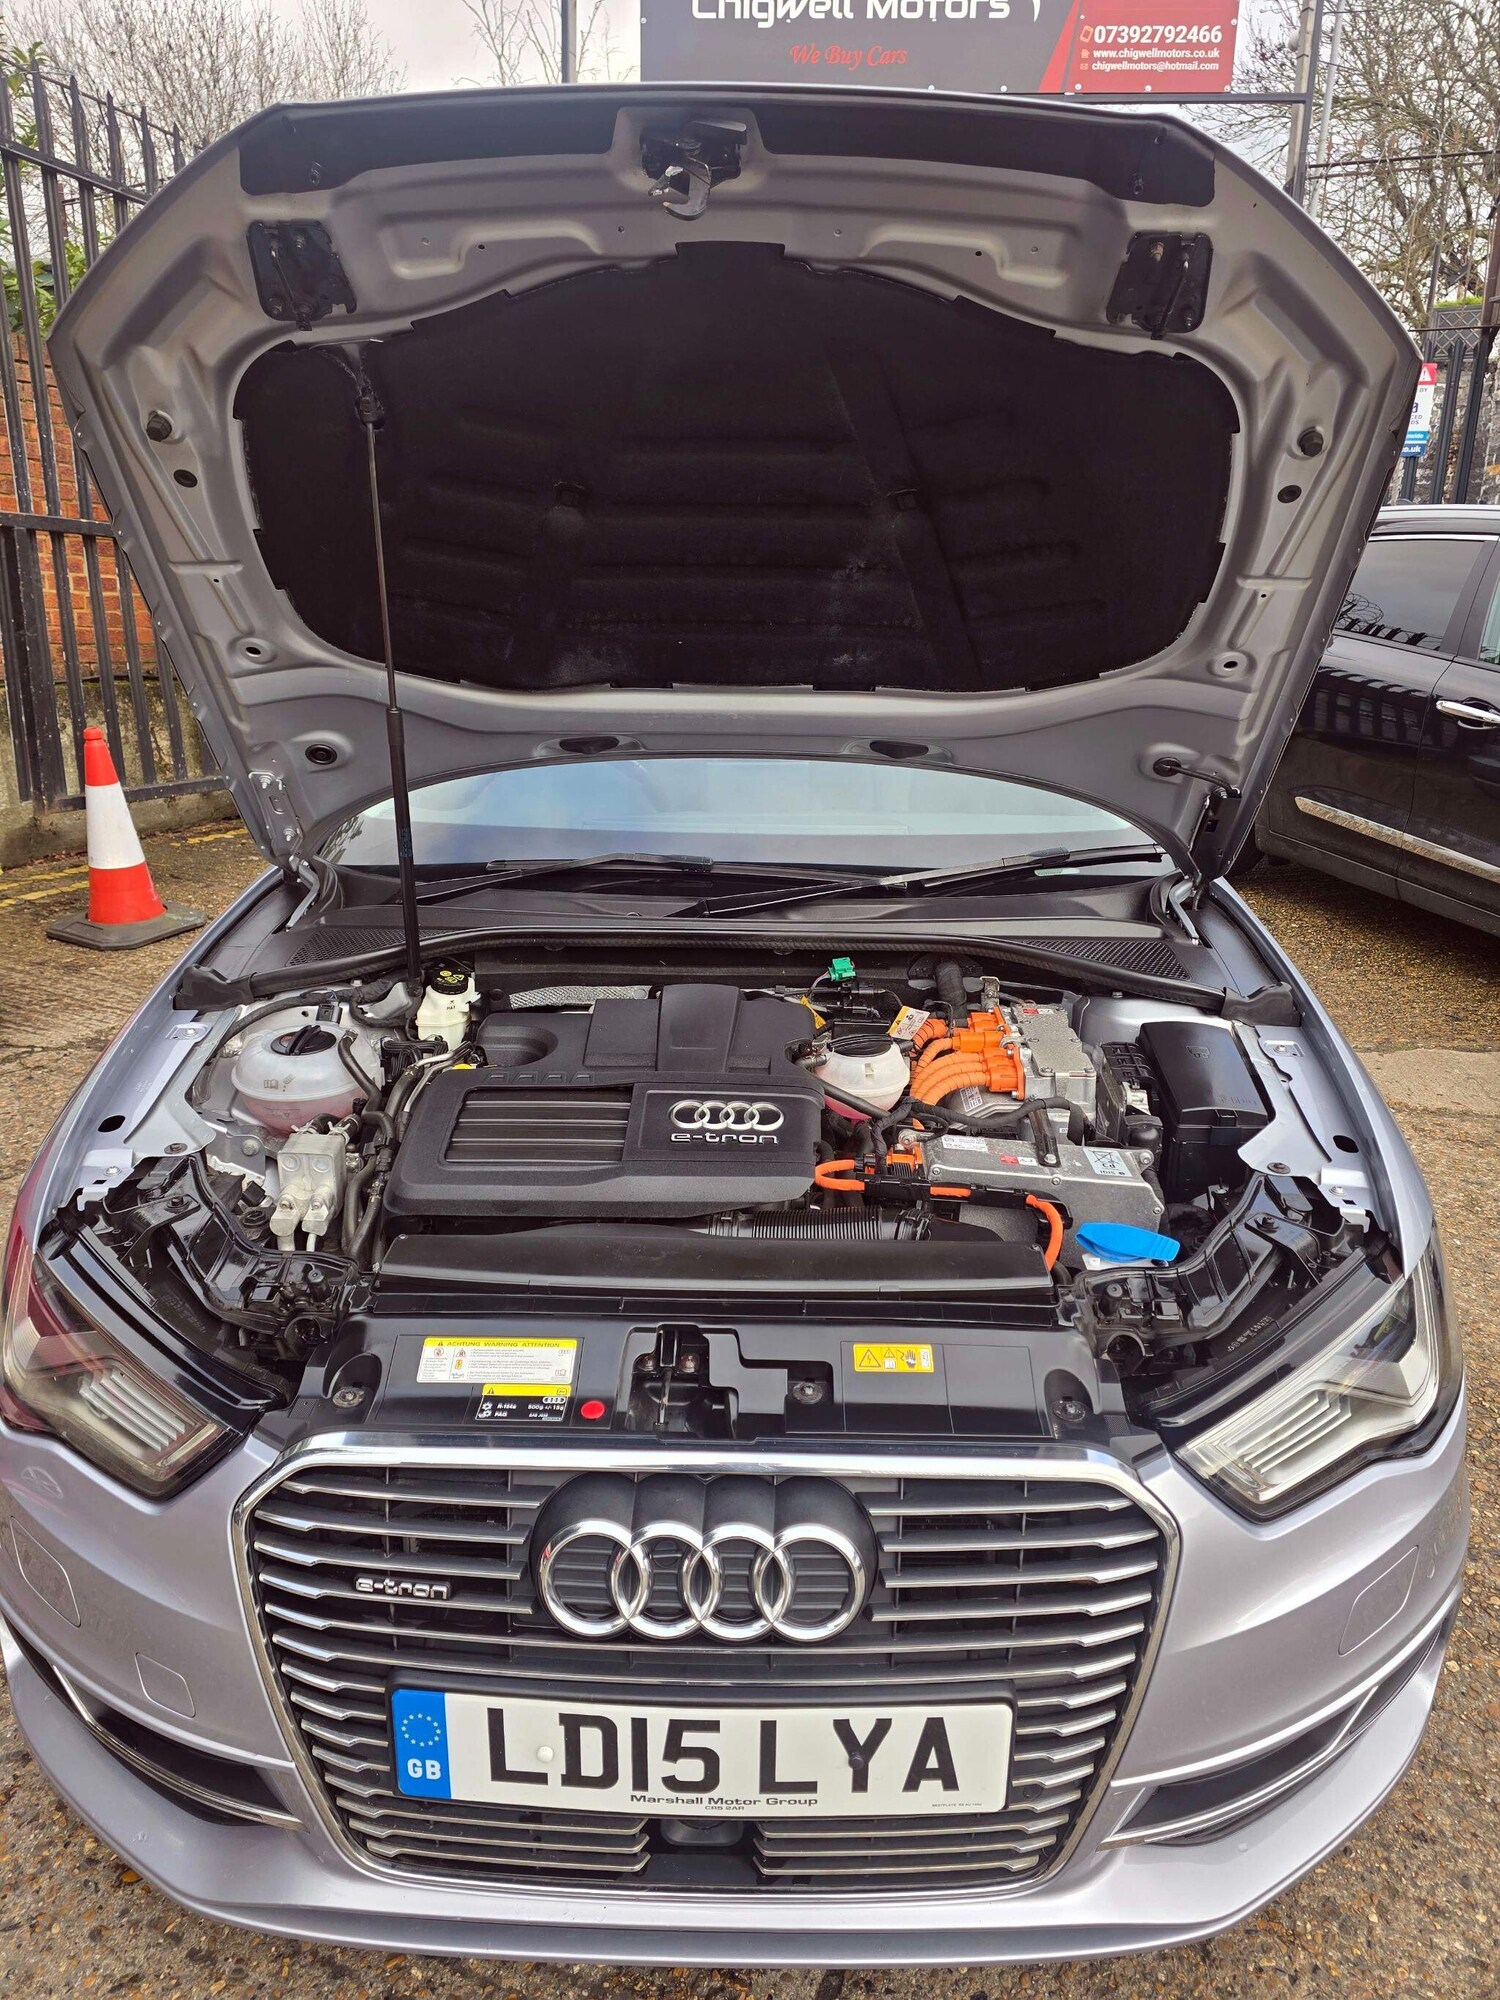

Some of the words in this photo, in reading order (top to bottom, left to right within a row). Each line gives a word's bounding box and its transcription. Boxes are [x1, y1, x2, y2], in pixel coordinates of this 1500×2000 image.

[1093, 25, 1222, 44] 07392792466
[789, 43, 818, 65] We
[825, 45, 863, 70] Buy
[866, 45, 909, 67] Cars
[1092, 48, 1220, 59] www.chigwellmotors.co.uk
[1091, 61, 1220, 72] chigwellmotors@hotmail.com
[670, 1132, 779, 1145] e-tron
[355, 1577, 448, 1600] e-tron
[486, 1706, 721, 1794] LD15
[759, 1715, 960, 1795] LYA
[407, 1758, 442, 1780] GB
[630, 1794, 703, 1805] Marshall
[708, 1797, 762, 1806] Motor
[765, 1797, 818, 1807] Group
